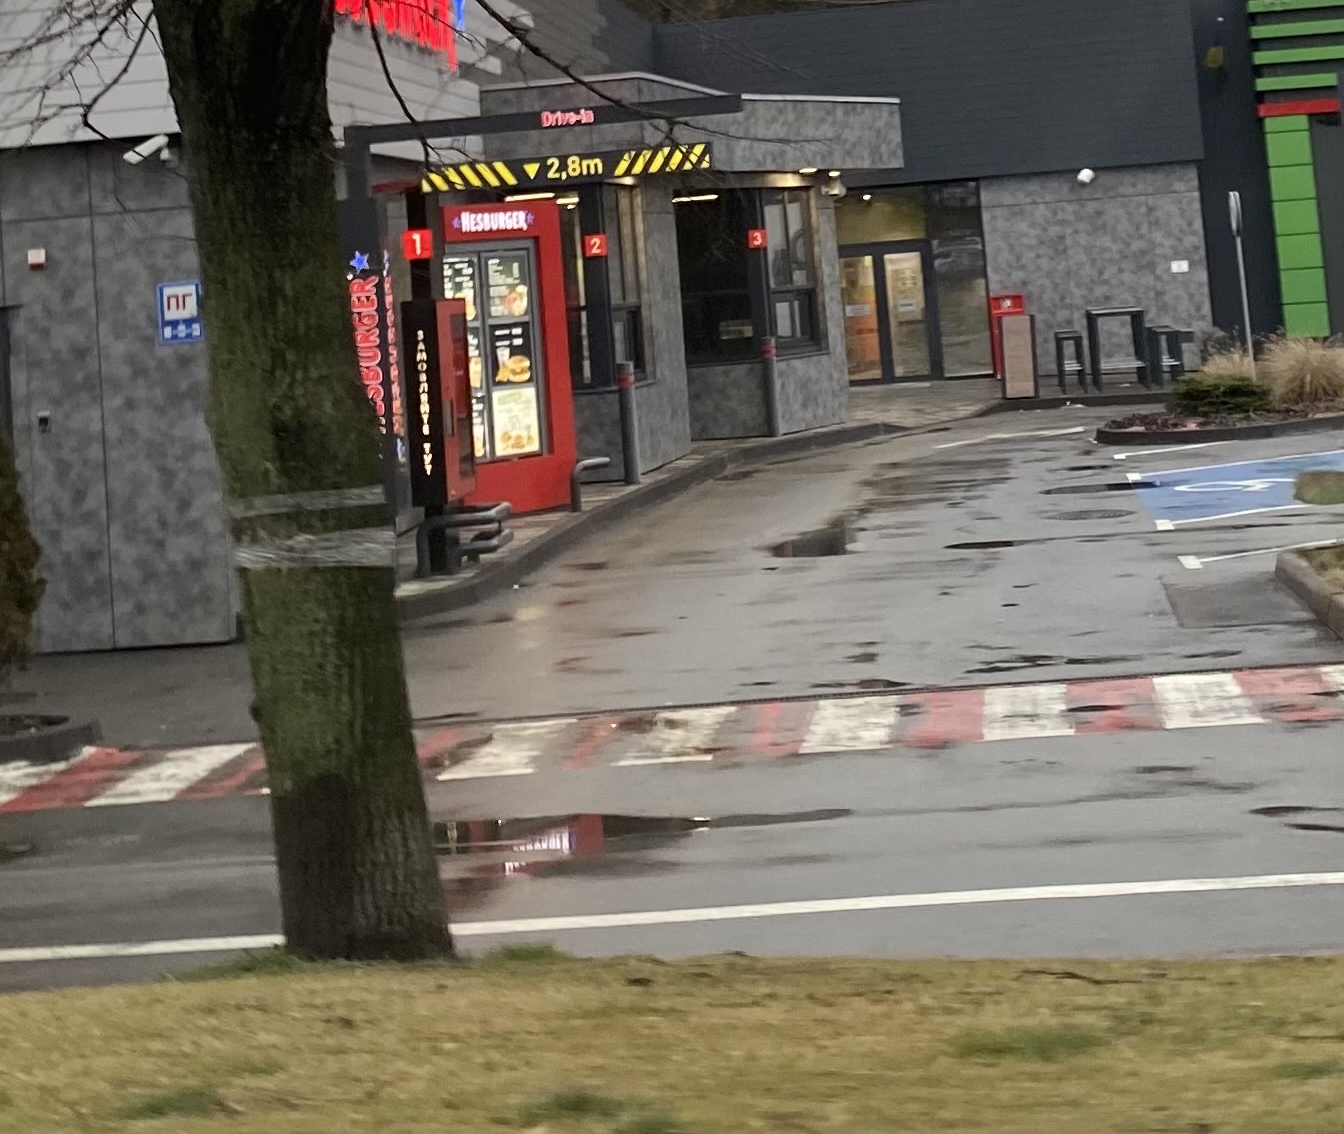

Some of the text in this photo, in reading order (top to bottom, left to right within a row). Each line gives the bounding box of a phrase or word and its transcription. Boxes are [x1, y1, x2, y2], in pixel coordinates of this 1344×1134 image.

[540, 108, 595, 128] Drive-in
[546, 155, 603, 180] 2,8m
[460, 210, 528, 233] HESBURGER
[412, 233, 422, 256] 1
[590, 237, 602, 254] 2
[753, 232, 762, 246] 3
